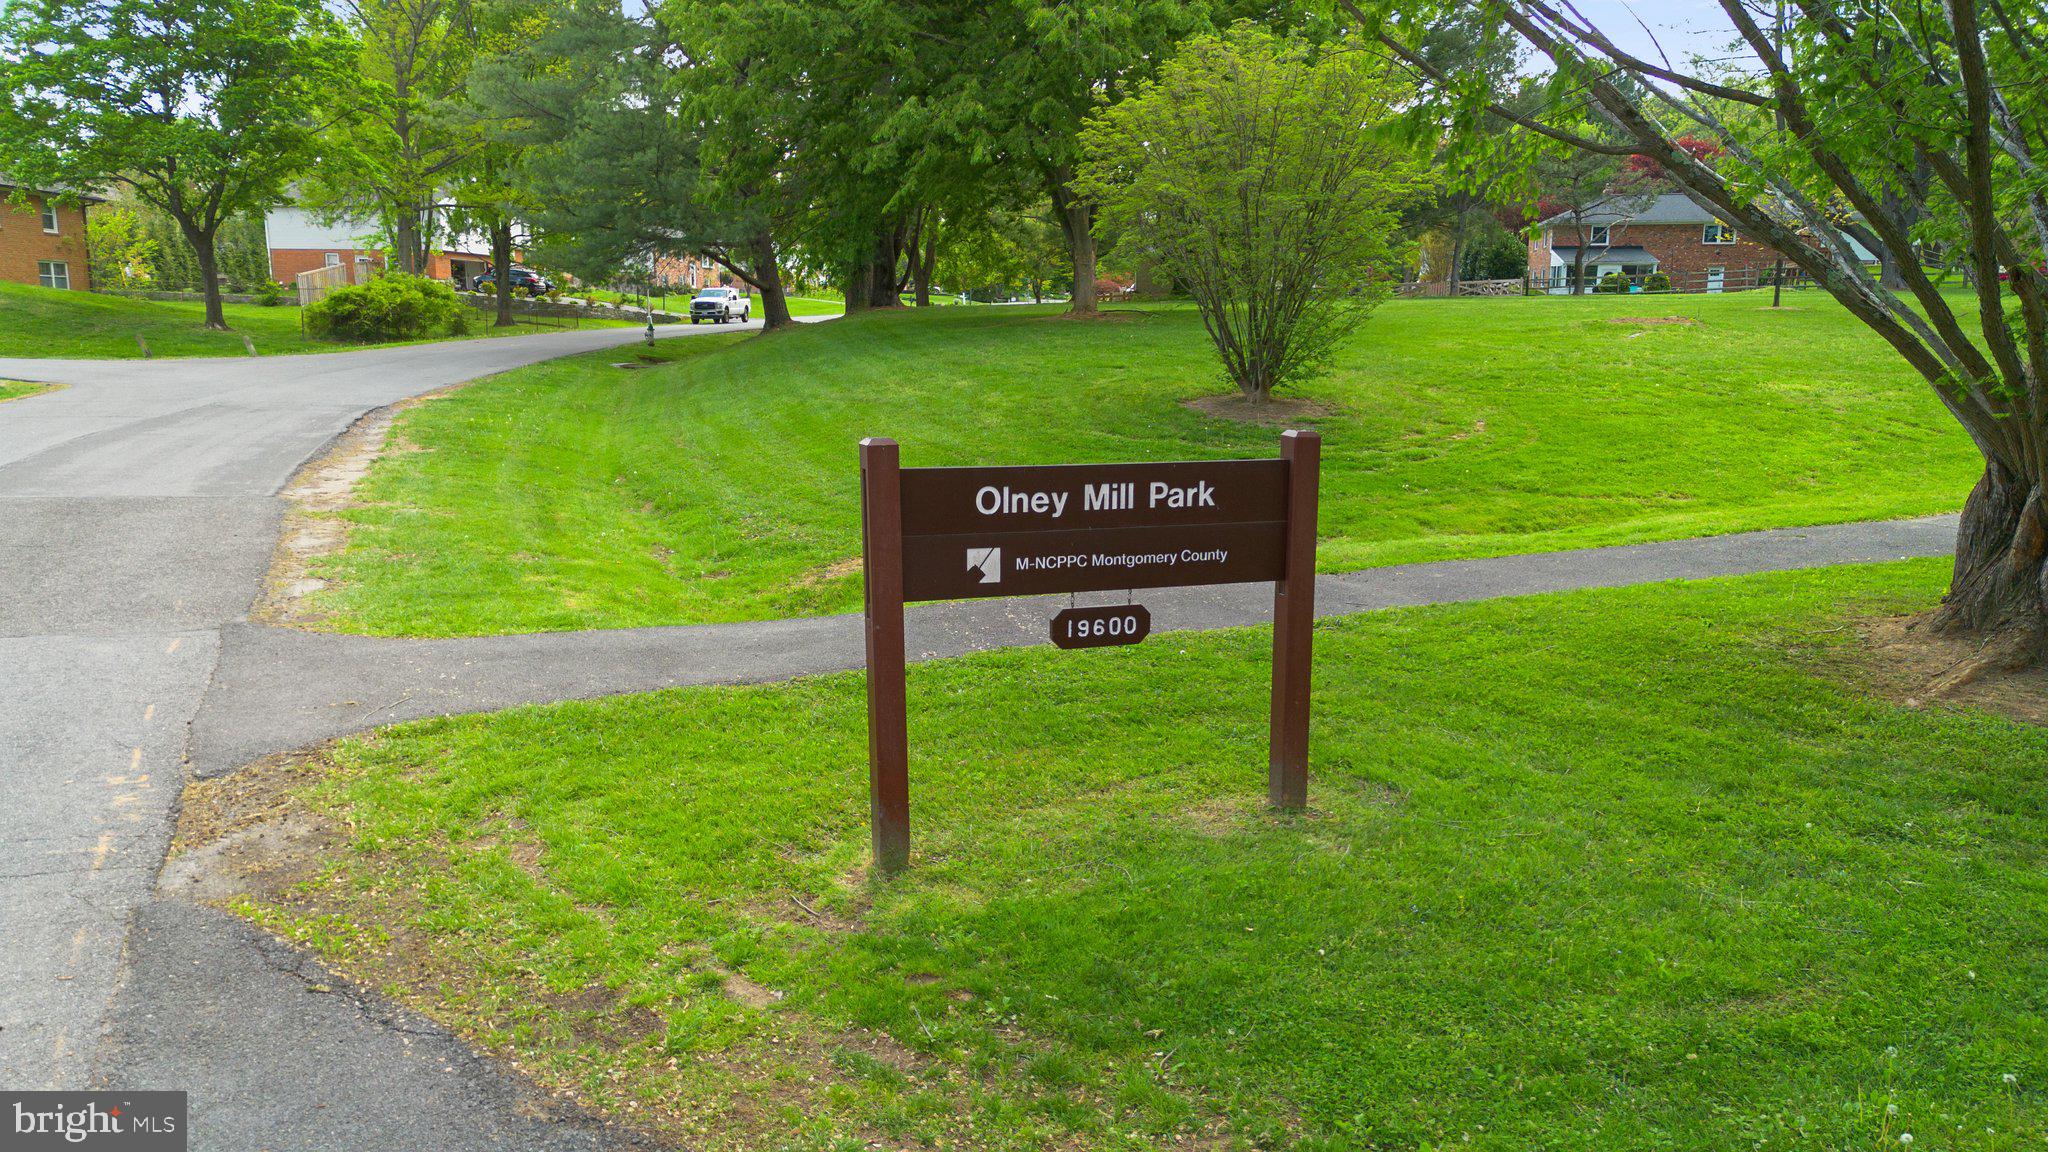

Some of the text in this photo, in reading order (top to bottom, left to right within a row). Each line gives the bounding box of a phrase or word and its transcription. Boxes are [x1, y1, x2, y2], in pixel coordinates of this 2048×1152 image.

[975, 480, 1215, 518] Olney Mill Park
[1016, 547, 1228, 570] M-NCPPC Montgomery County
[1067, 616, 1137, 638] 19600
